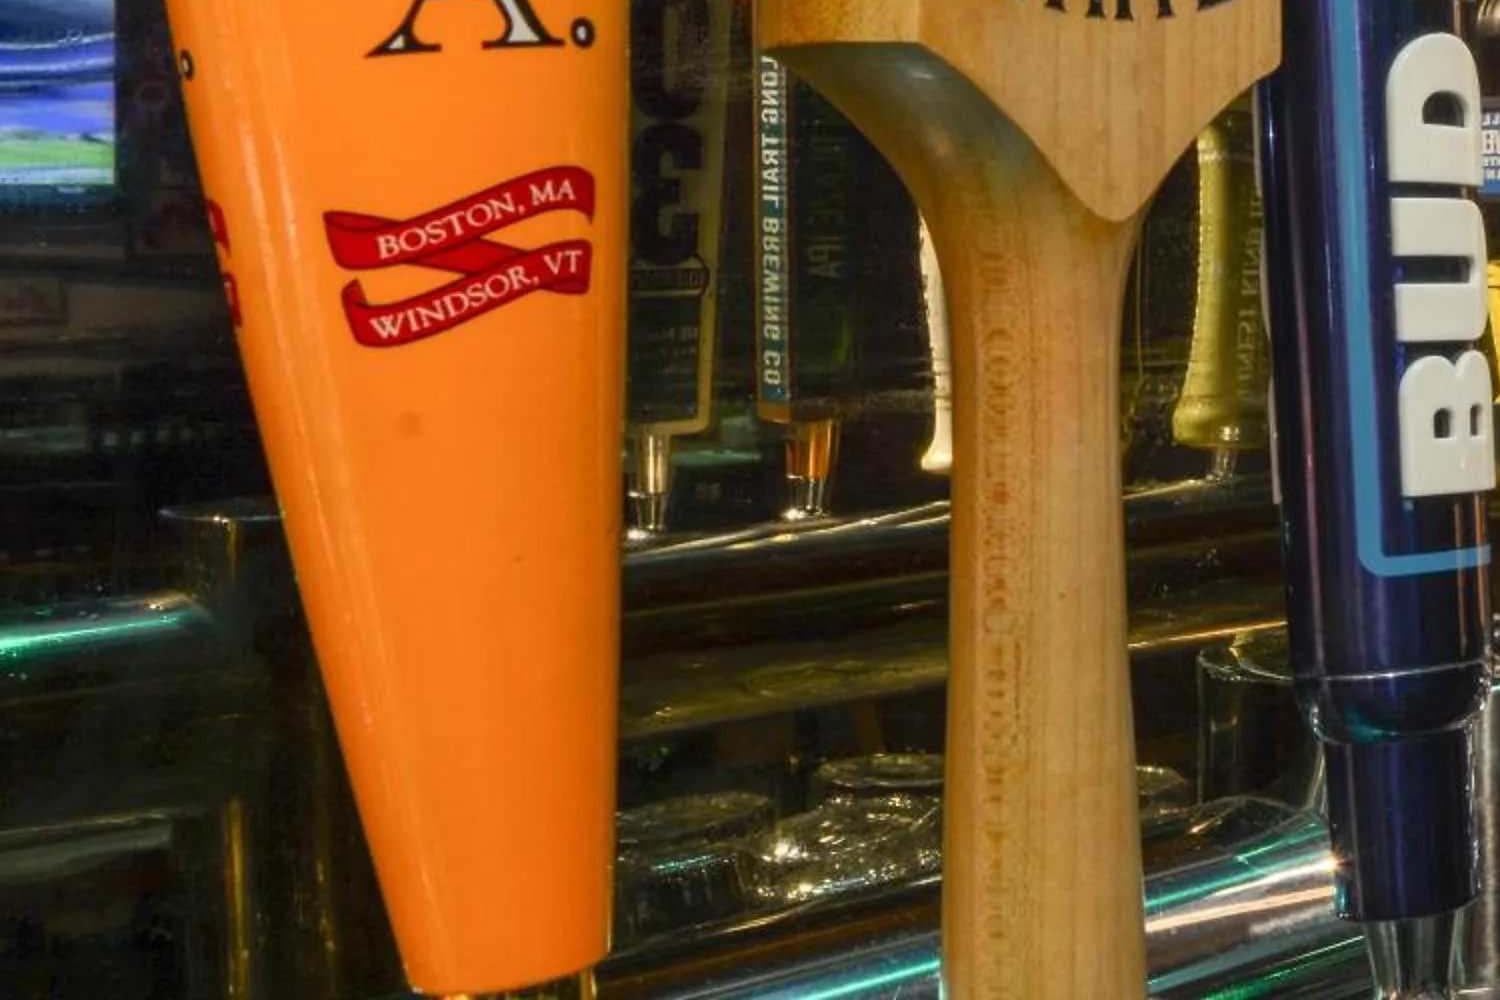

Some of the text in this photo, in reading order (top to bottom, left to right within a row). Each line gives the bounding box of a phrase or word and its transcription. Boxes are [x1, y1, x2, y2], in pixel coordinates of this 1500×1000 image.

[377, 178, 577, 262] BOSTON, MA
[1385, 31, 1497, 497] BUD
[369, 250, 584, 340] WINDSOR, VT
